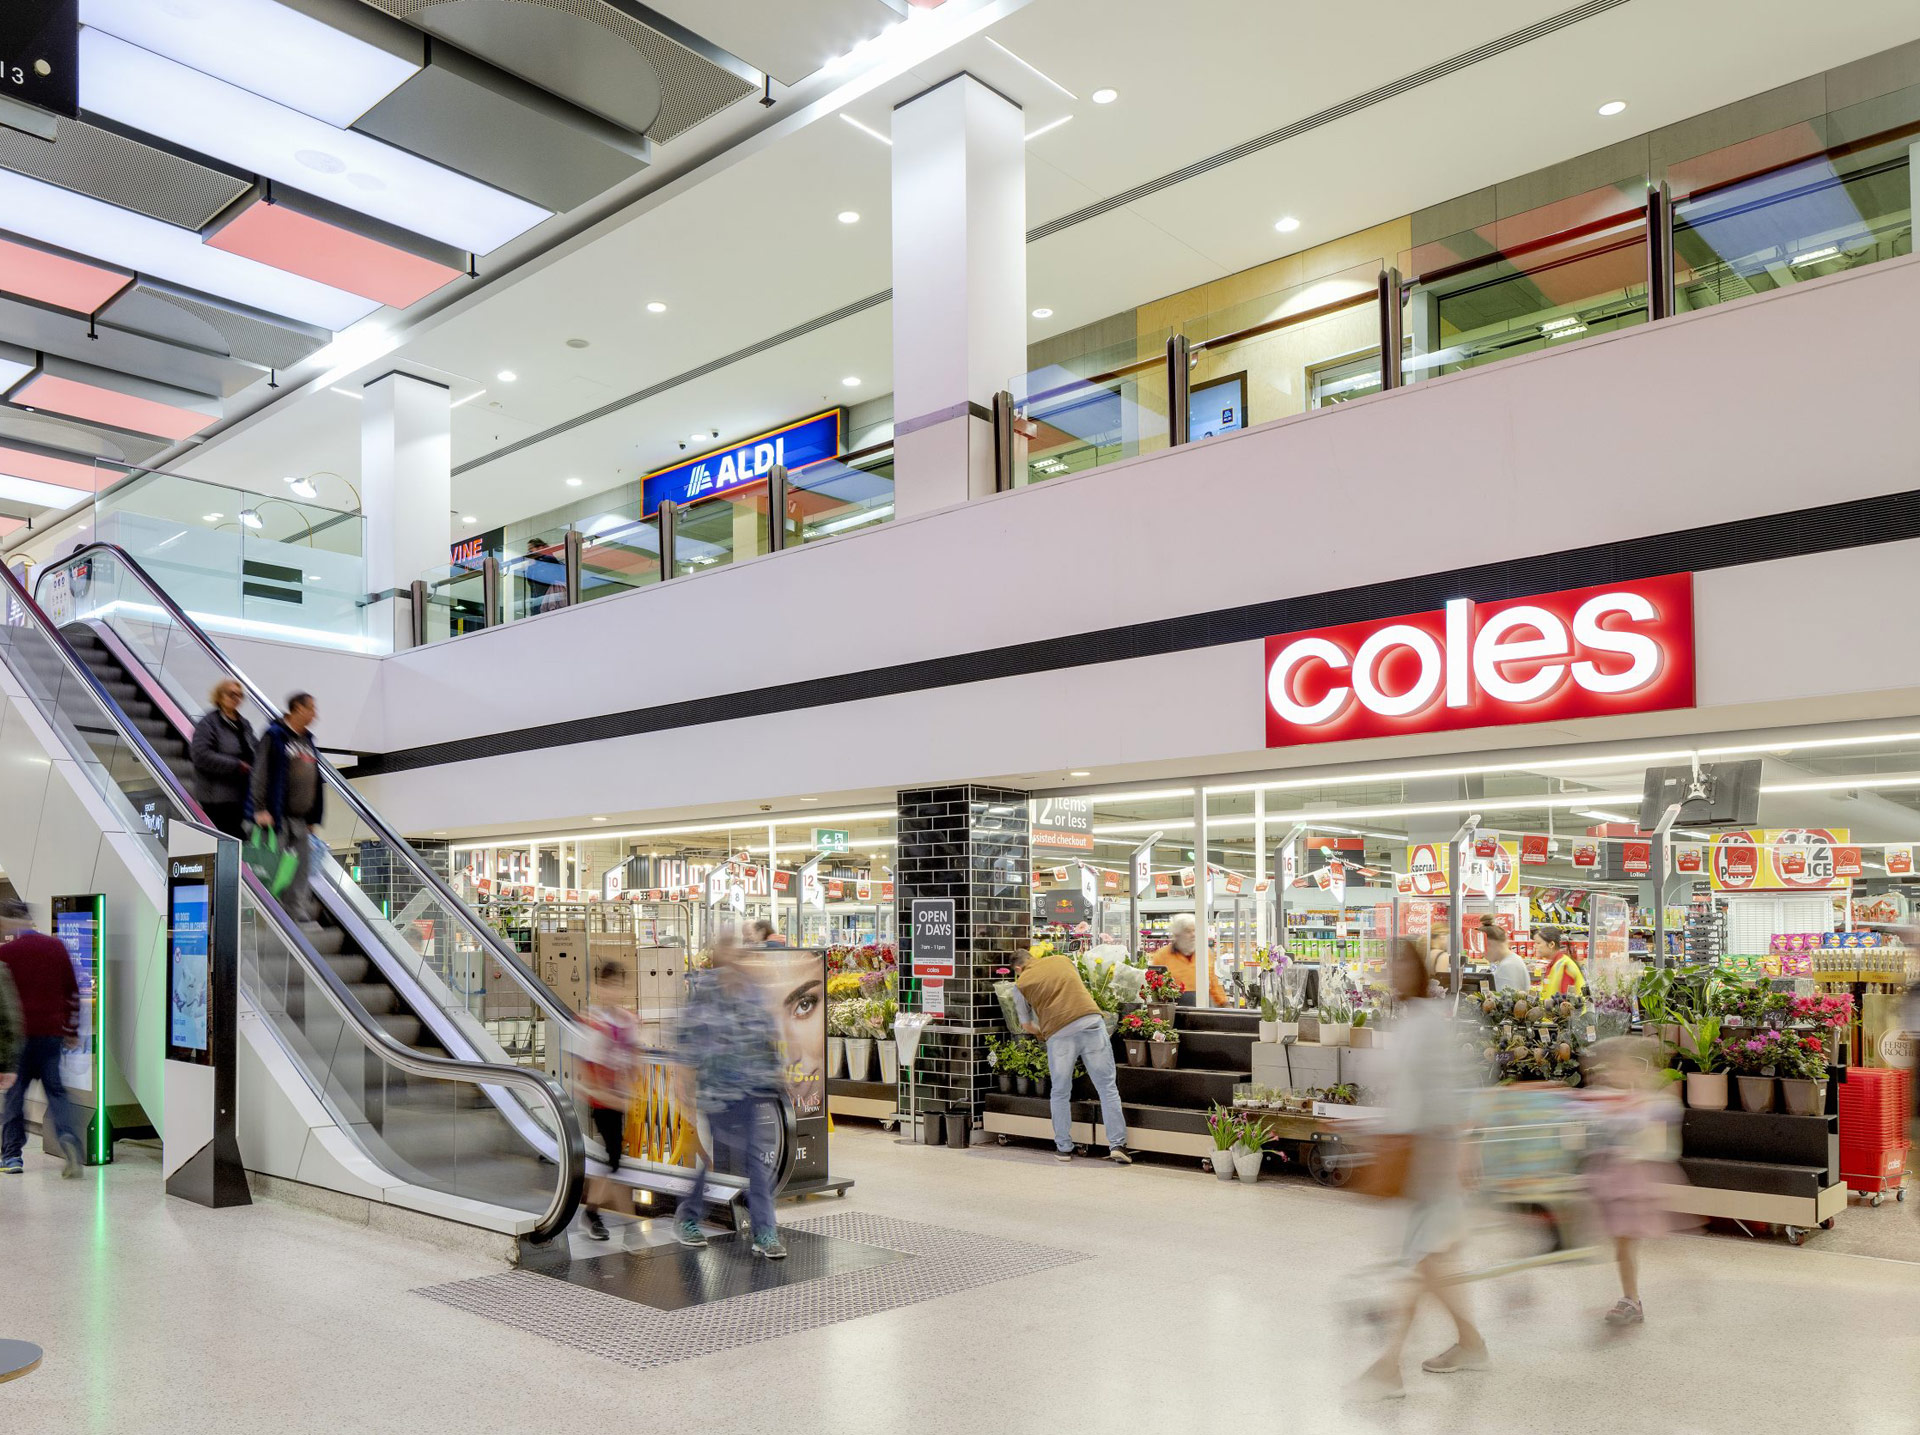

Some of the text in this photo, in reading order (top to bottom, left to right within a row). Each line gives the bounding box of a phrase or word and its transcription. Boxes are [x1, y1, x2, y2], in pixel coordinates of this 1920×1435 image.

[716, 437, 784, 488] ALDI
[1268, 592, 1663, 725] coles
[1054, 812, 1087, 829] or less
[1032, 832, 1087, 847] ssisted checkout
[1333, 838, 1338, 848] 3
[180, 864, 203, 874] Information
[1138, 863, 1148, 876] 15
[1283, 857, 1293, 871] 16
[609, 877, 619, 888] 10
[712, 879, 721, 890] 11
[803, 874, 814, 887] 12
[734, 892, 740, 902] 8
[918, 910, 948, 923] OPEN
[916, 923, 952, 936] 7 DAYS
[804, 1104, 821, 1113] Brow
